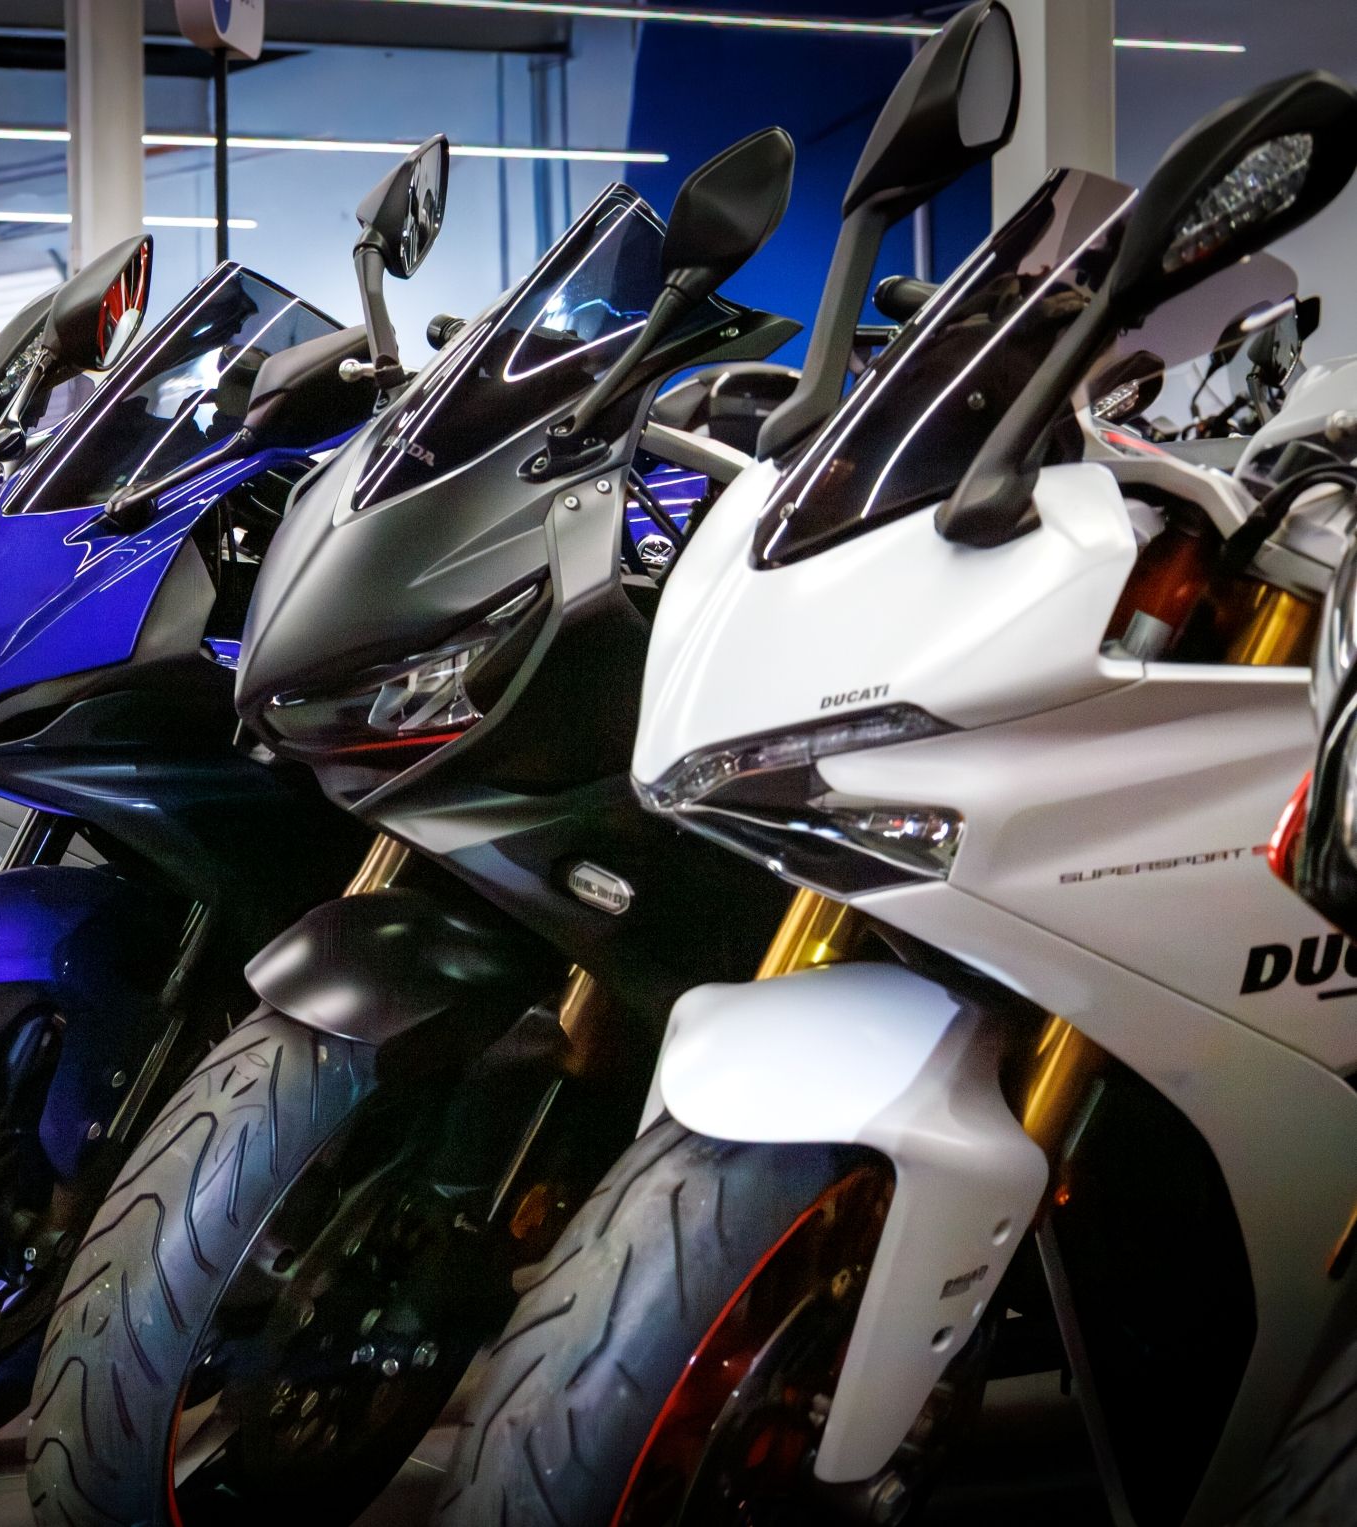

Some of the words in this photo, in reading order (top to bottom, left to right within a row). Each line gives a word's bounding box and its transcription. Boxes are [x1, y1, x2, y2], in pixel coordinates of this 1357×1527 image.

[820, 683, 890, 710] DUCATI
[1059, 847, 1246, 884] SUPERSPORT
[1239, 932, 1357, 996] DU
